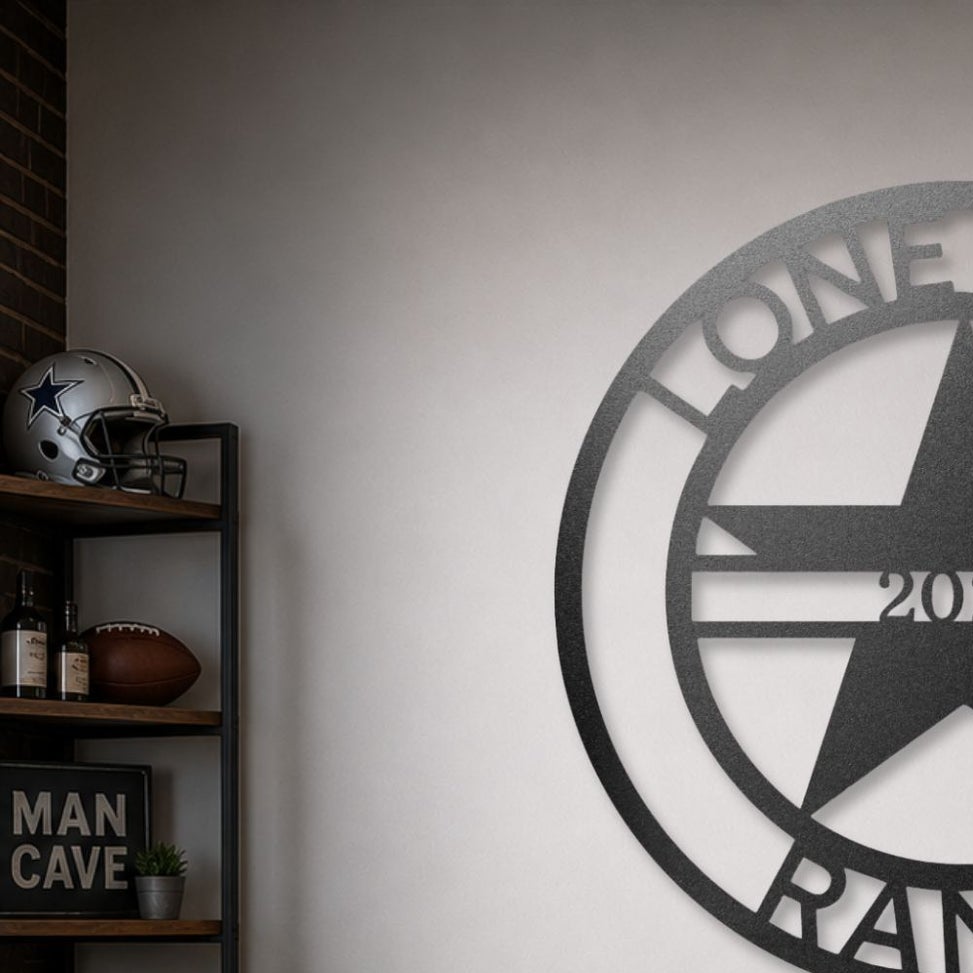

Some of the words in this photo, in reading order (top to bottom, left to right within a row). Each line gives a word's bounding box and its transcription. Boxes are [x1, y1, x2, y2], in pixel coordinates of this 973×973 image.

[636, 212, 956, 436] LONE
[12, 790, 127, 837] MAN
[11, 843, 129, 889] CAVE
